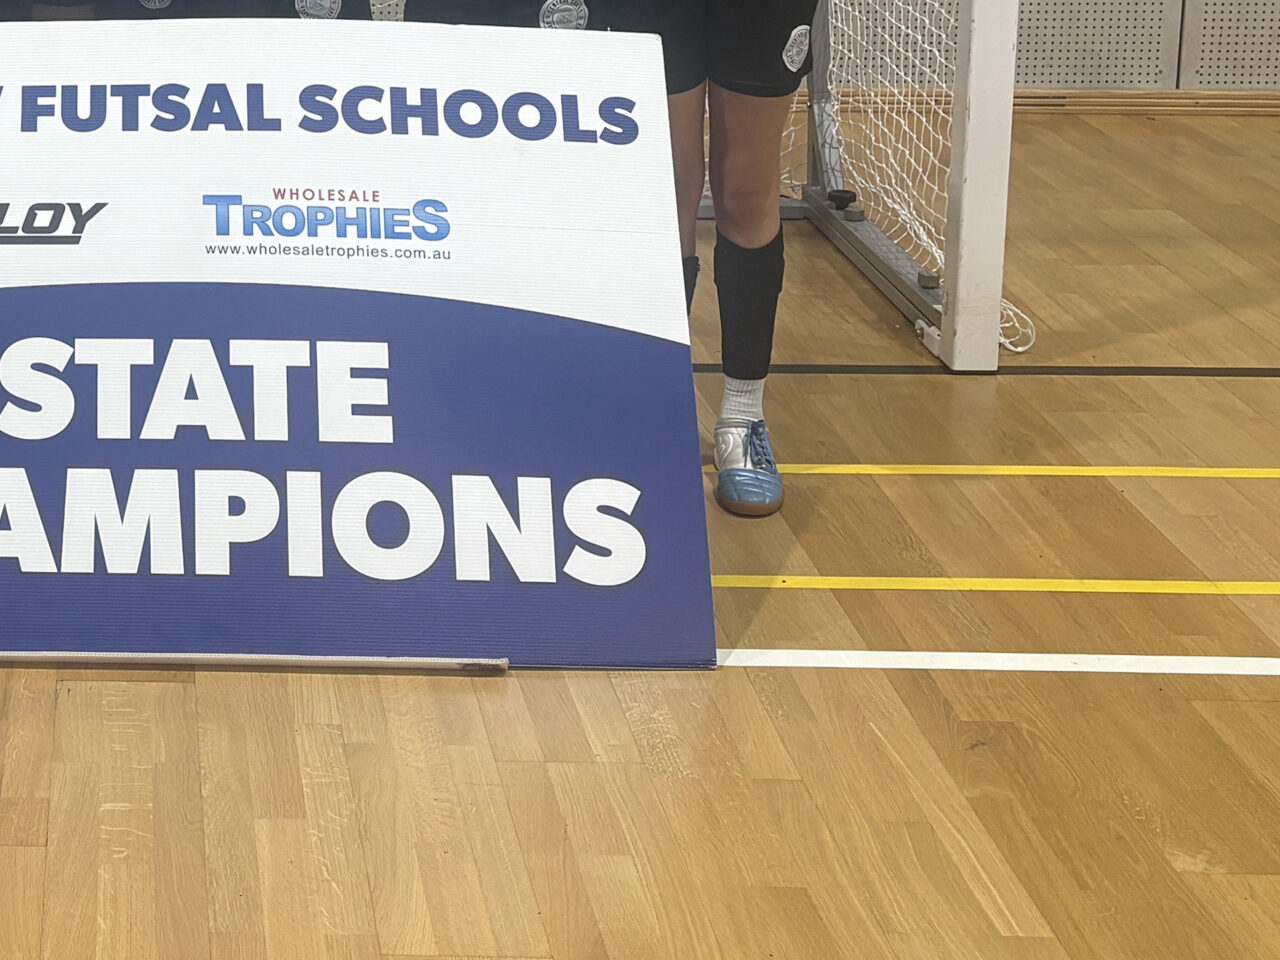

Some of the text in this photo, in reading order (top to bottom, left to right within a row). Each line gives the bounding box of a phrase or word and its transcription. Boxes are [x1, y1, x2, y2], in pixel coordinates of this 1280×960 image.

[21, 84, 282, 132] FUTSAL
[299, 85, 639, 145] SCHOOLS
[272, 187, 381, 202] WHOLESALE
[202, 194, 451, 242] TROPHIES
[205, 243, 451, 260] www.wholesaletrophies.com.au
